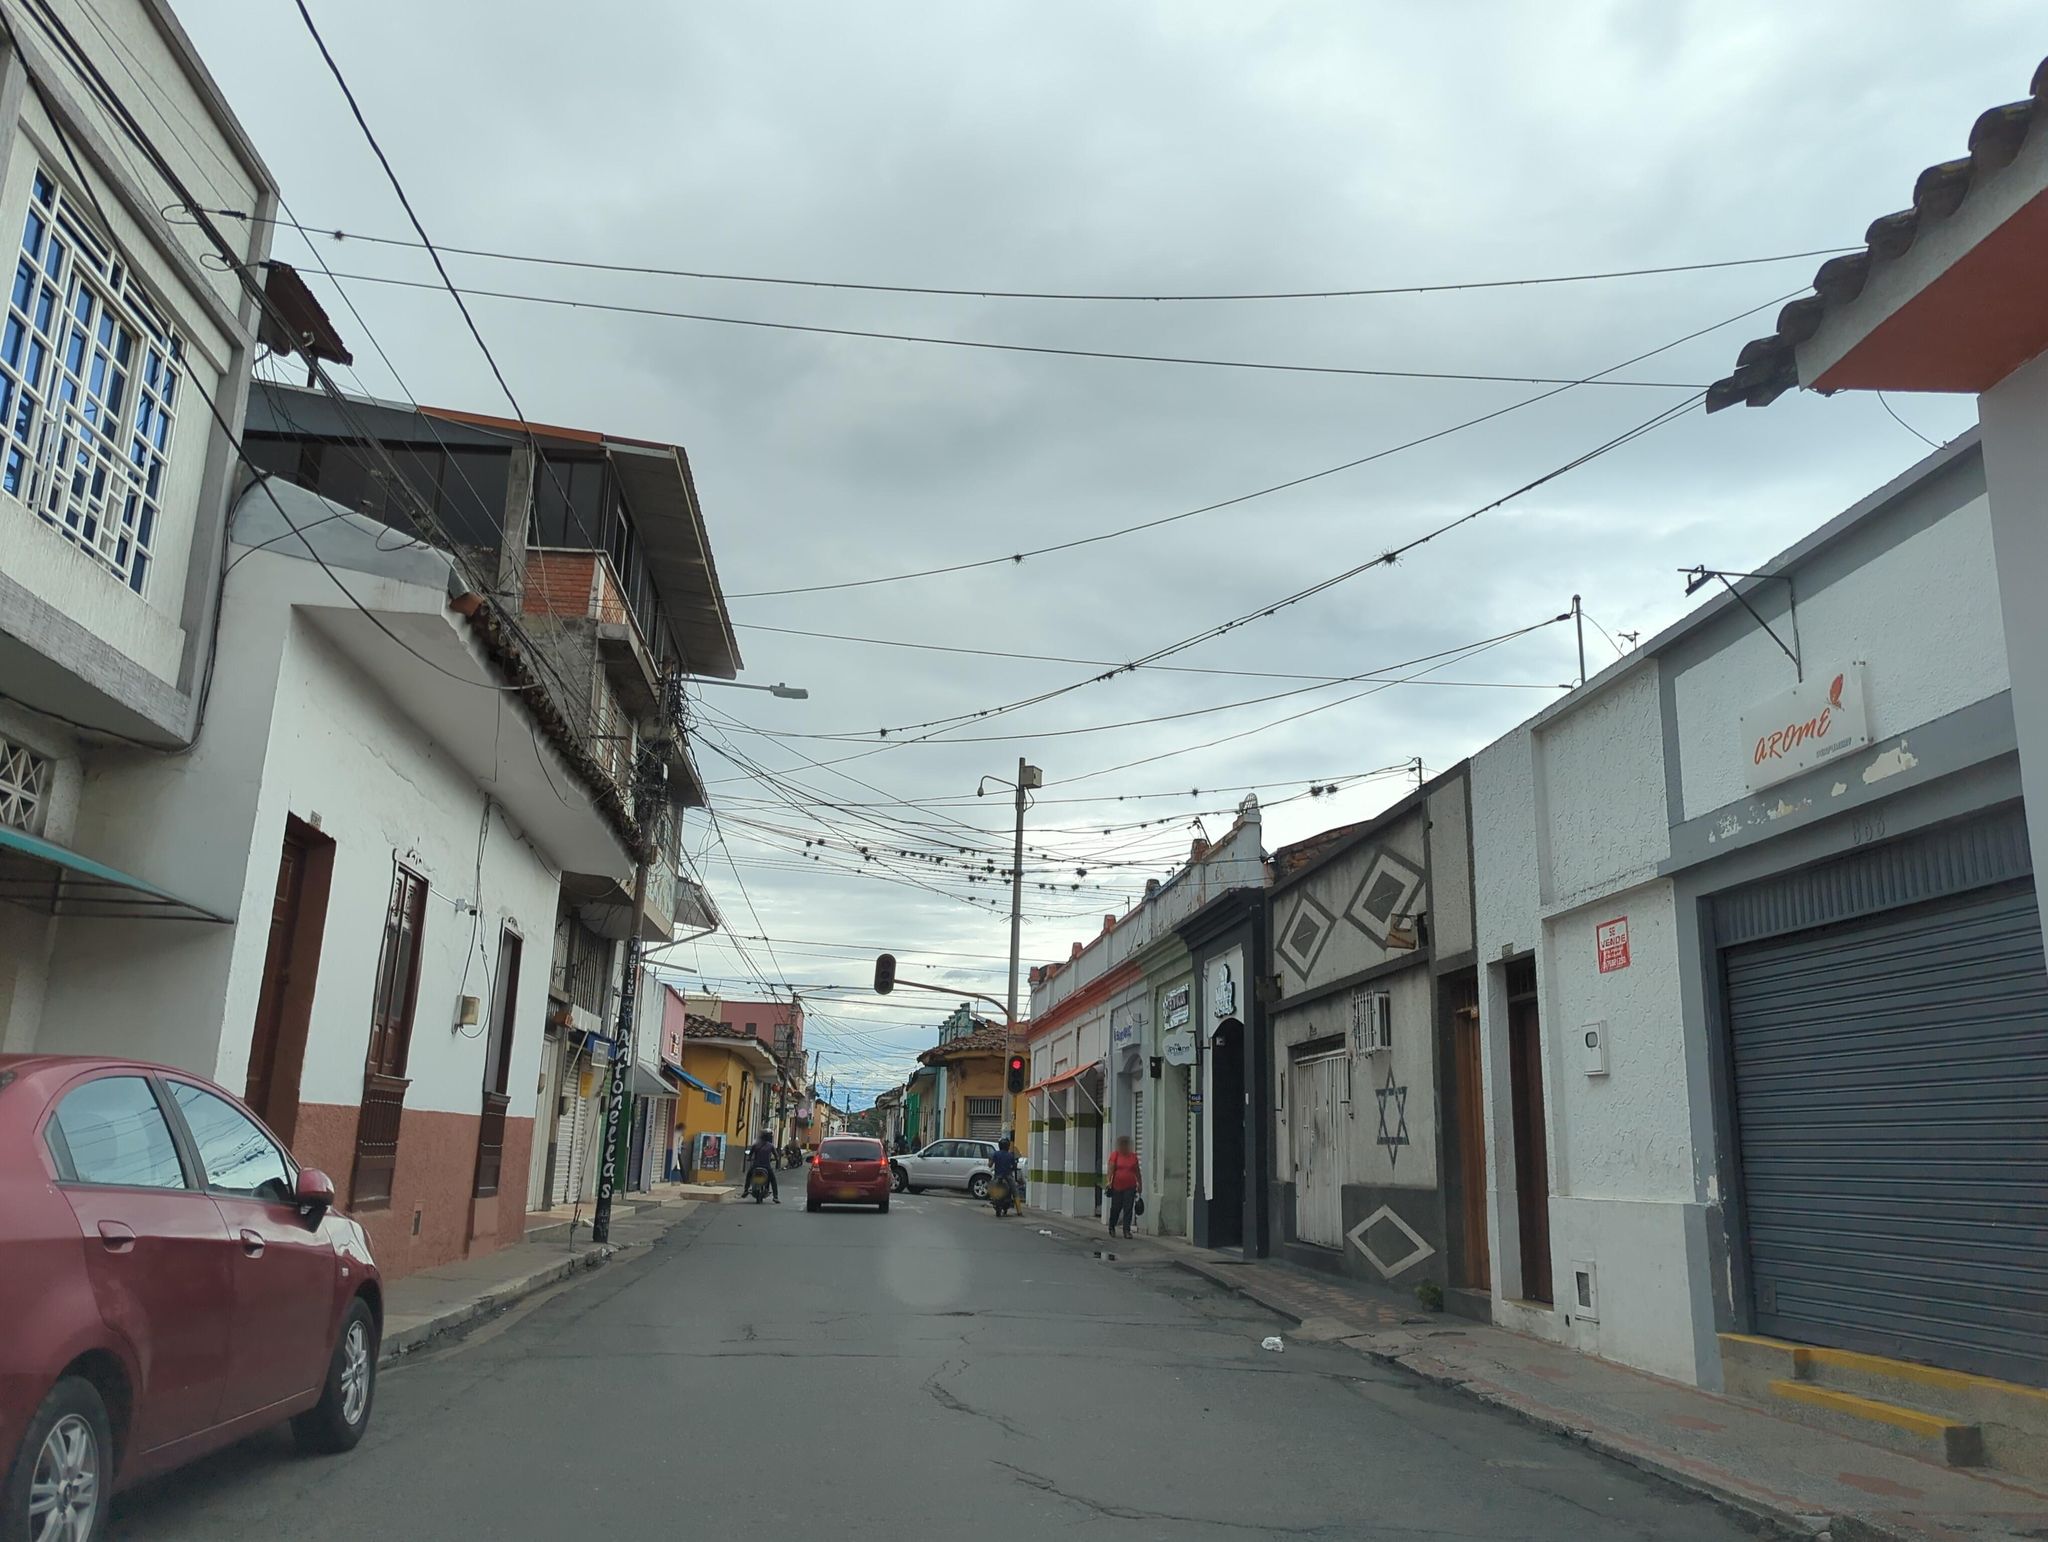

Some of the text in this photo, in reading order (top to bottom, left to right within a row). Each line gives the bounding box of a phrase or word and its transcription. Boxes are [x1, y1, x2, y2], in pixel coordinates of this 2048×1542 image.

[1753, 706, 1832, 765] AROME
[1608, 926, 1616, 937] SE
[1600, 934, 1626, 948] VENDE
